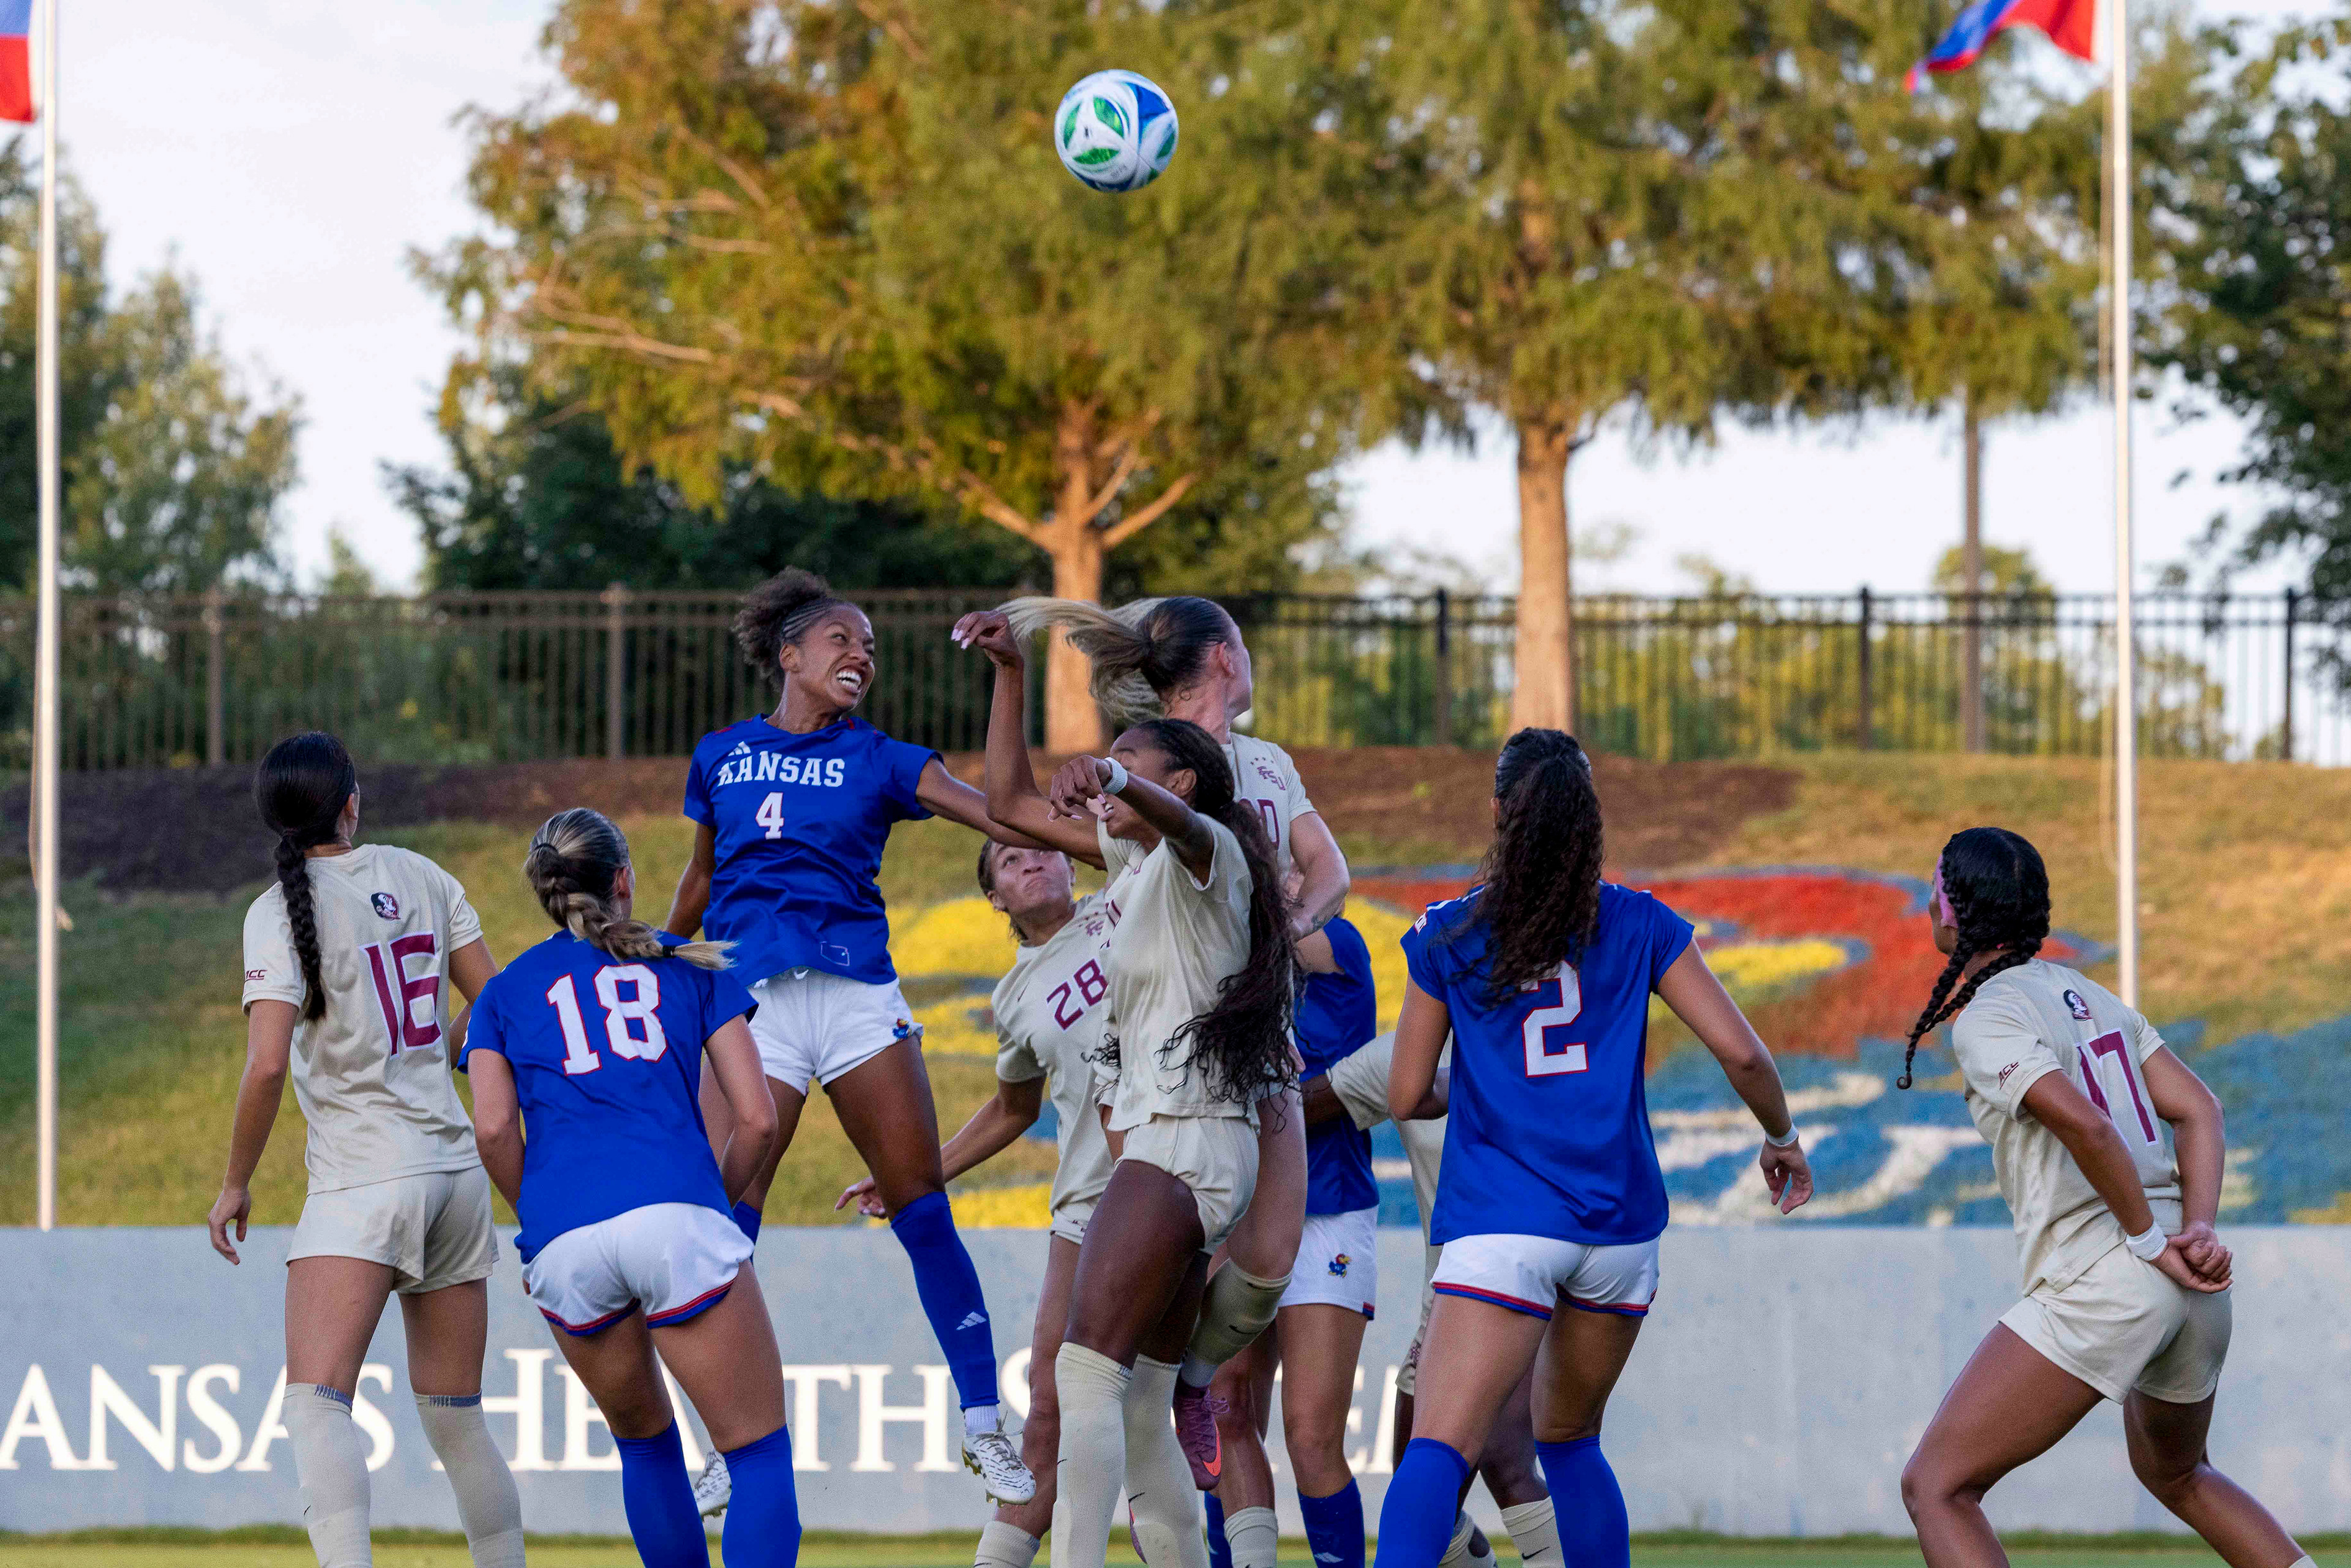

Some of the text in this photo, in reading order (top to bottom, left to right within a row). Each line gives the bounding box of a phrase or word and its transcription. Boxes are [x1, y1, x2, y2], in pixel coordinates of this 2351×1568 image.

[718, 750, 846, 788] KANSAS
[756, 792, 785, 841] 4
[359, 931, 443, 1060] 16
[546, 962, 669, 1076] 18
[1045, 957, 1109, 1032] 28
[1521, 961, 1590, 1078] 2
[2075, 1028, 2159, 1149] 17
